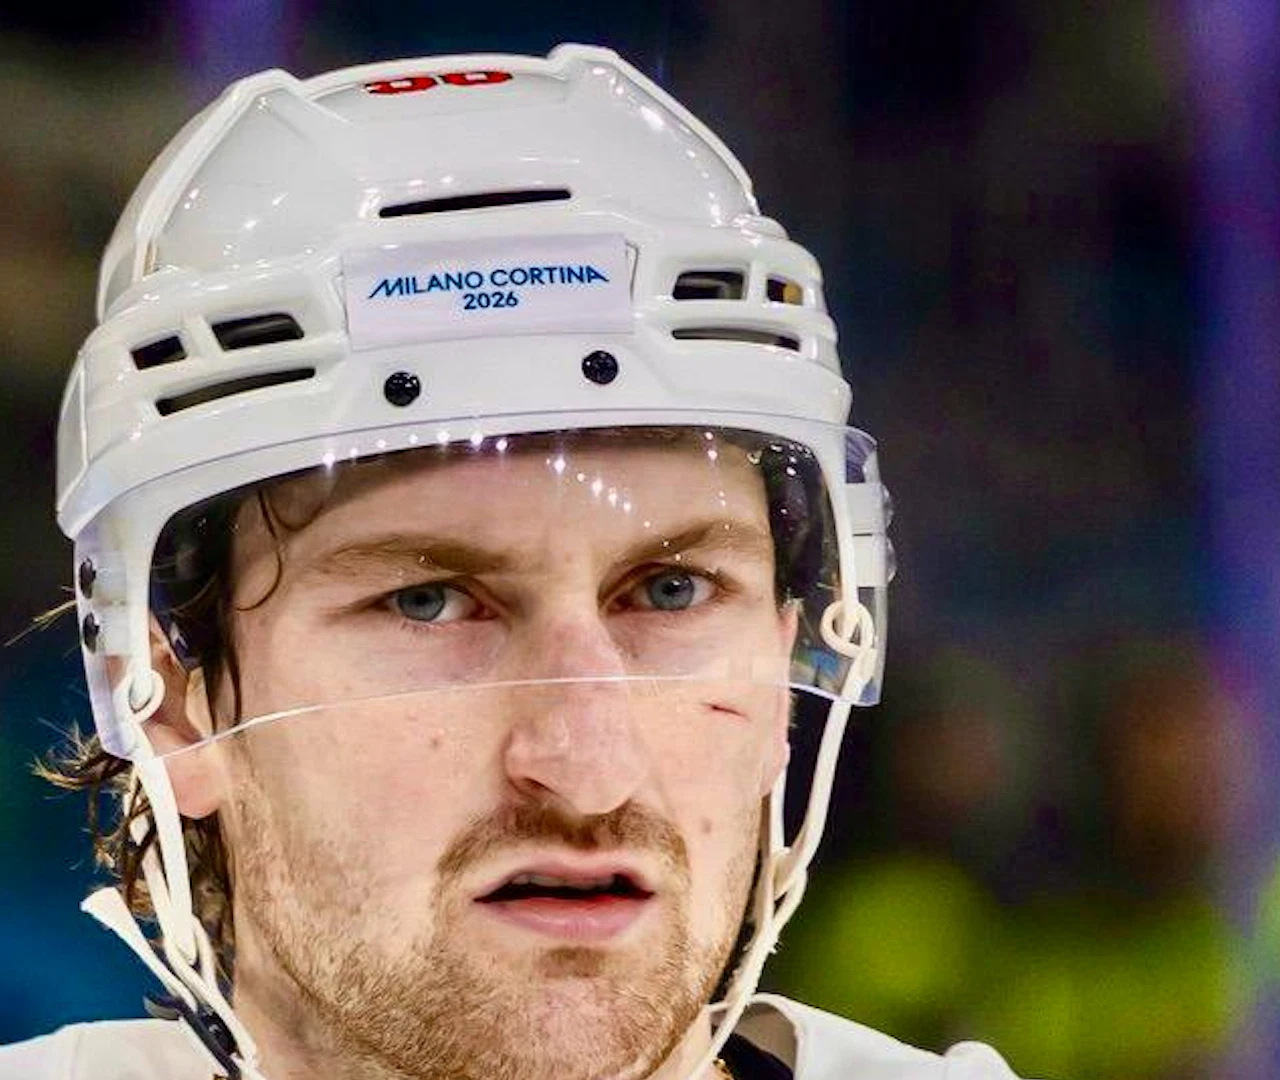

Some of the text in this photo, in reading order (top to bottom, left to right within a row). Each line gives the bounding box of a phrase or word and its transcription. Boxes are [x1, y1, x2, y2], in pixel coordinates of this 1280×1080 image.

[368, 265, 610, 299] MILANO CORTINA
[463, 291, 519, 311] 2026
